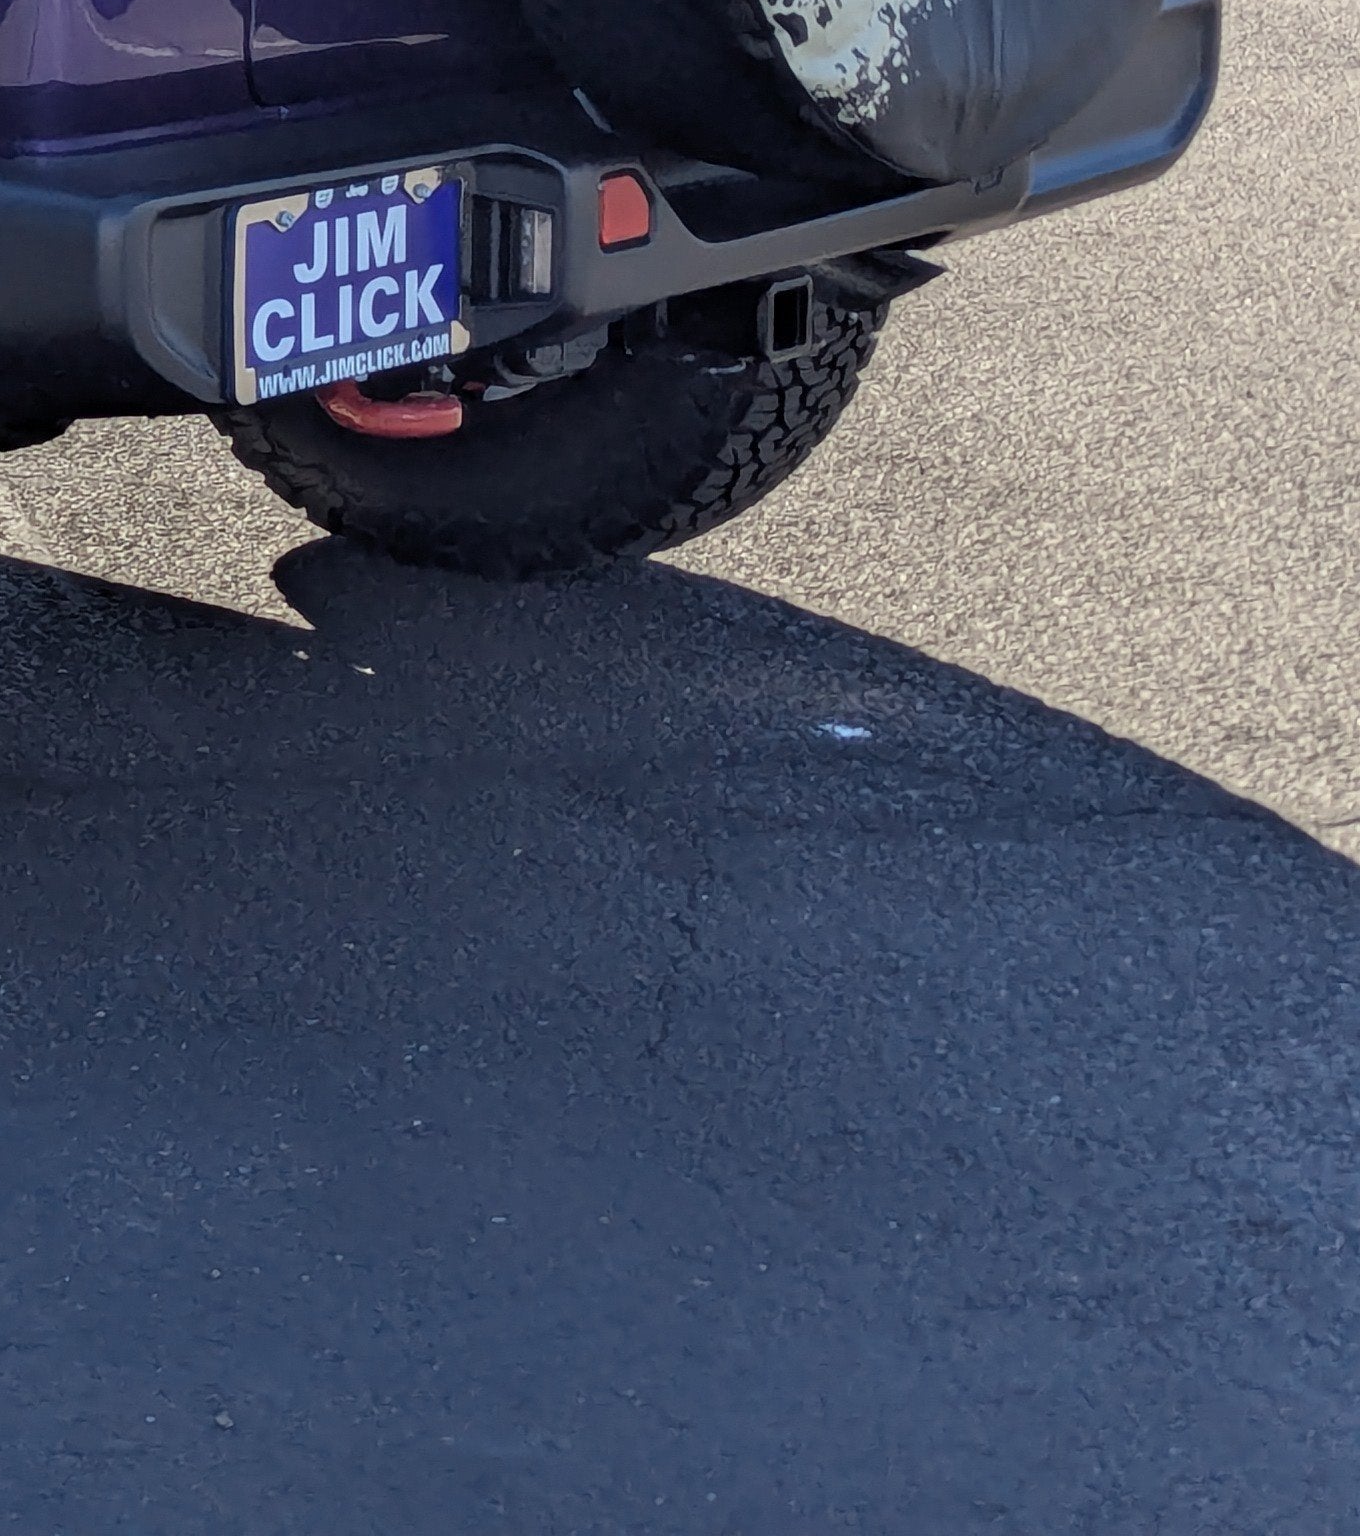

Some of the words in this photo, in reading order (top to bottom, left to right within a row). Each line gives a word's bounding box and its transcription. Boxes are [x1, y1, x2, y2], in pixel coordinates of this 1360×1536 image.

[293, 204, 407, 284] JIM
[252, 264, 444, 362] CLICK
[259, 333, 450, 399] WWW.JIMCLICK.COM
